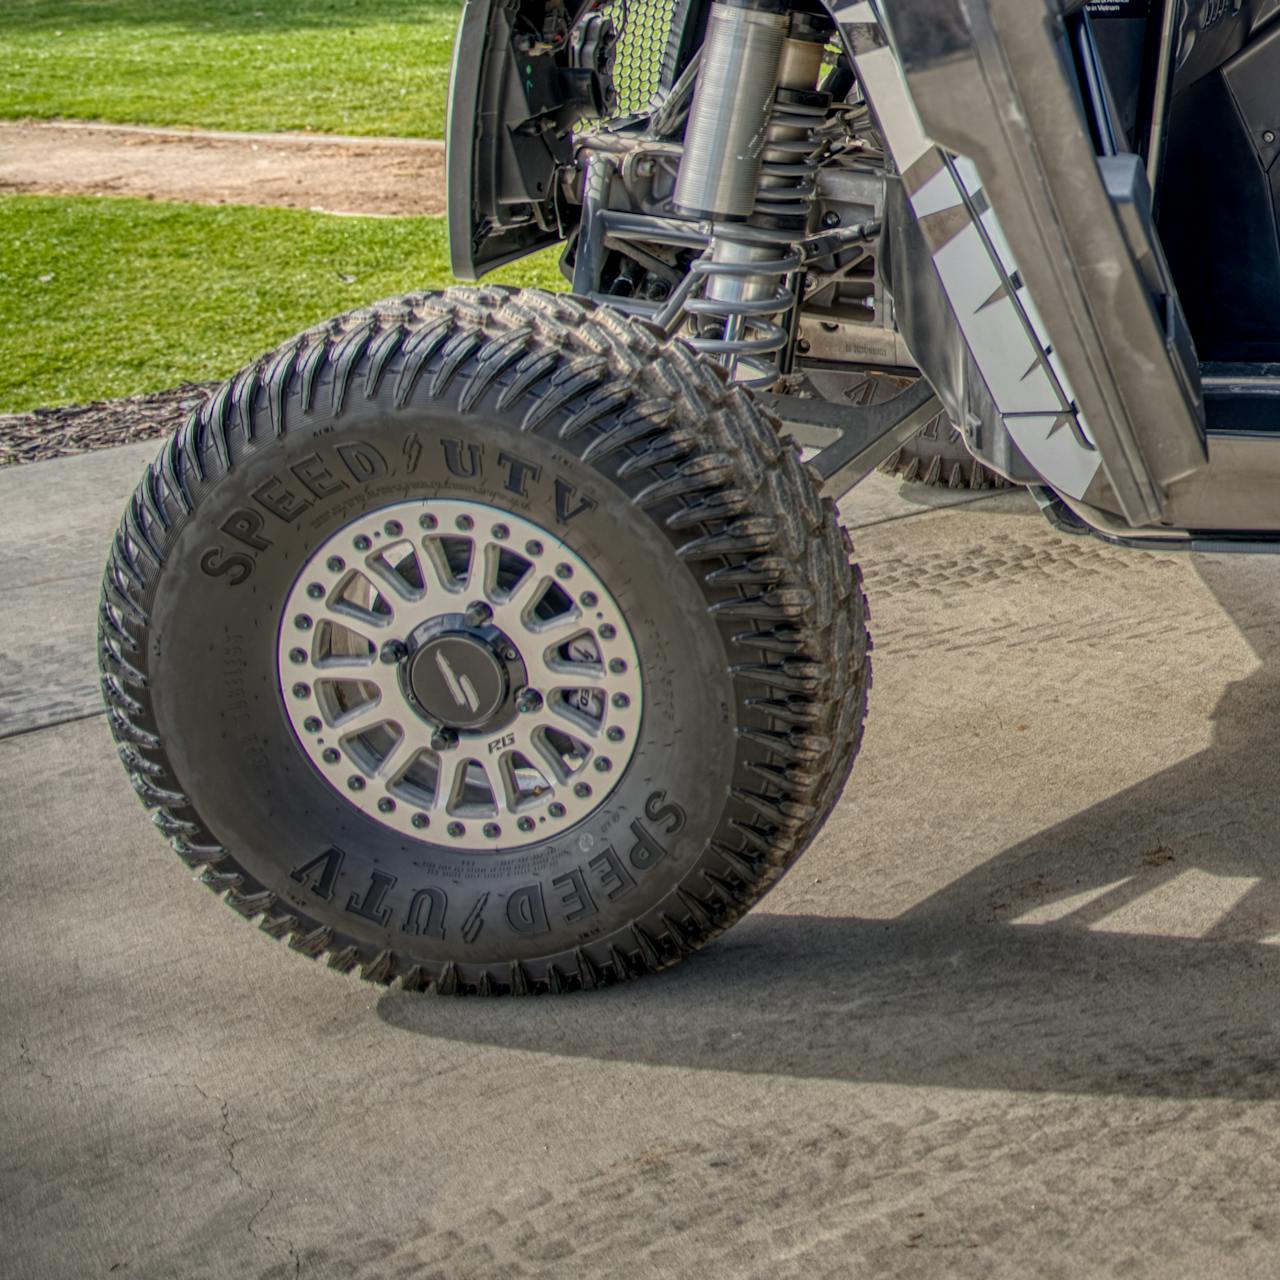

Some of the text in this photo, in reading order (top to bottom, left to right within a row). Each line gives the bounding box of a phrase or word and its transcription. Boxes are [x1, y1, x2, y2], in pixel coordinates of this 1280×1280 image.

[199, 440, 389, 587] SPEED
[440, 437, 598, 524] UTV
[290, 789, 687, 941] SPEED UTV
